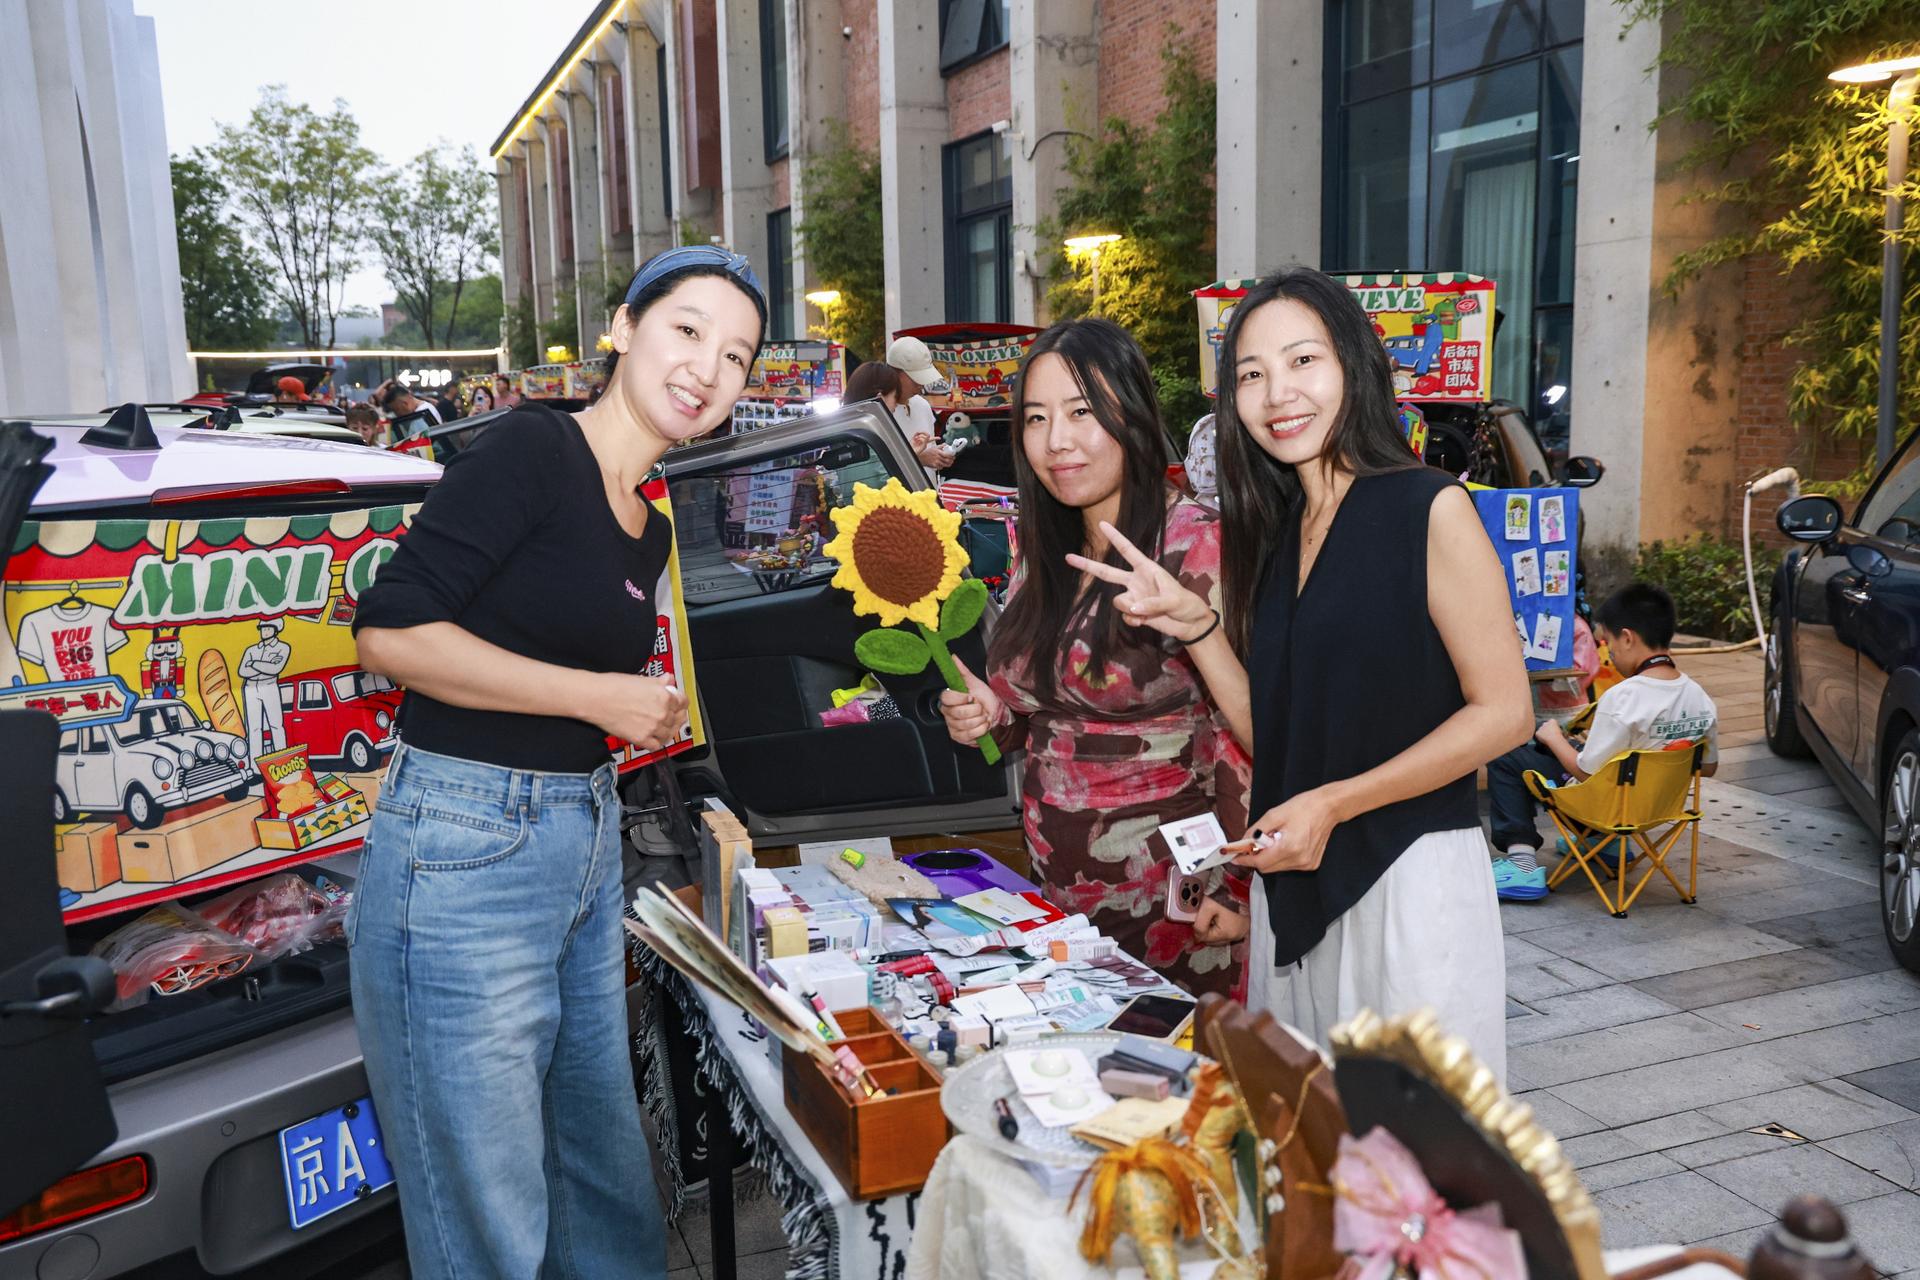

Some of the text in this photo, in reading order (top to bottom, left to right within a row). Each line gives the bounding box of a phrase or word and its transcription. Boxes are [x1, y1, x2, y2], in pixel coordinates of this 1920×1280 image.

[932, 350, 956, 362] INI
[1442, 345, 1479, 359] 后备箱
[1447, 359, 1475, 373] 市集
[1445, 374, 1476, 387] 团队
[124, 552, 327, 617] MINI
[1657, 723, 1685, 734] ENERGY
